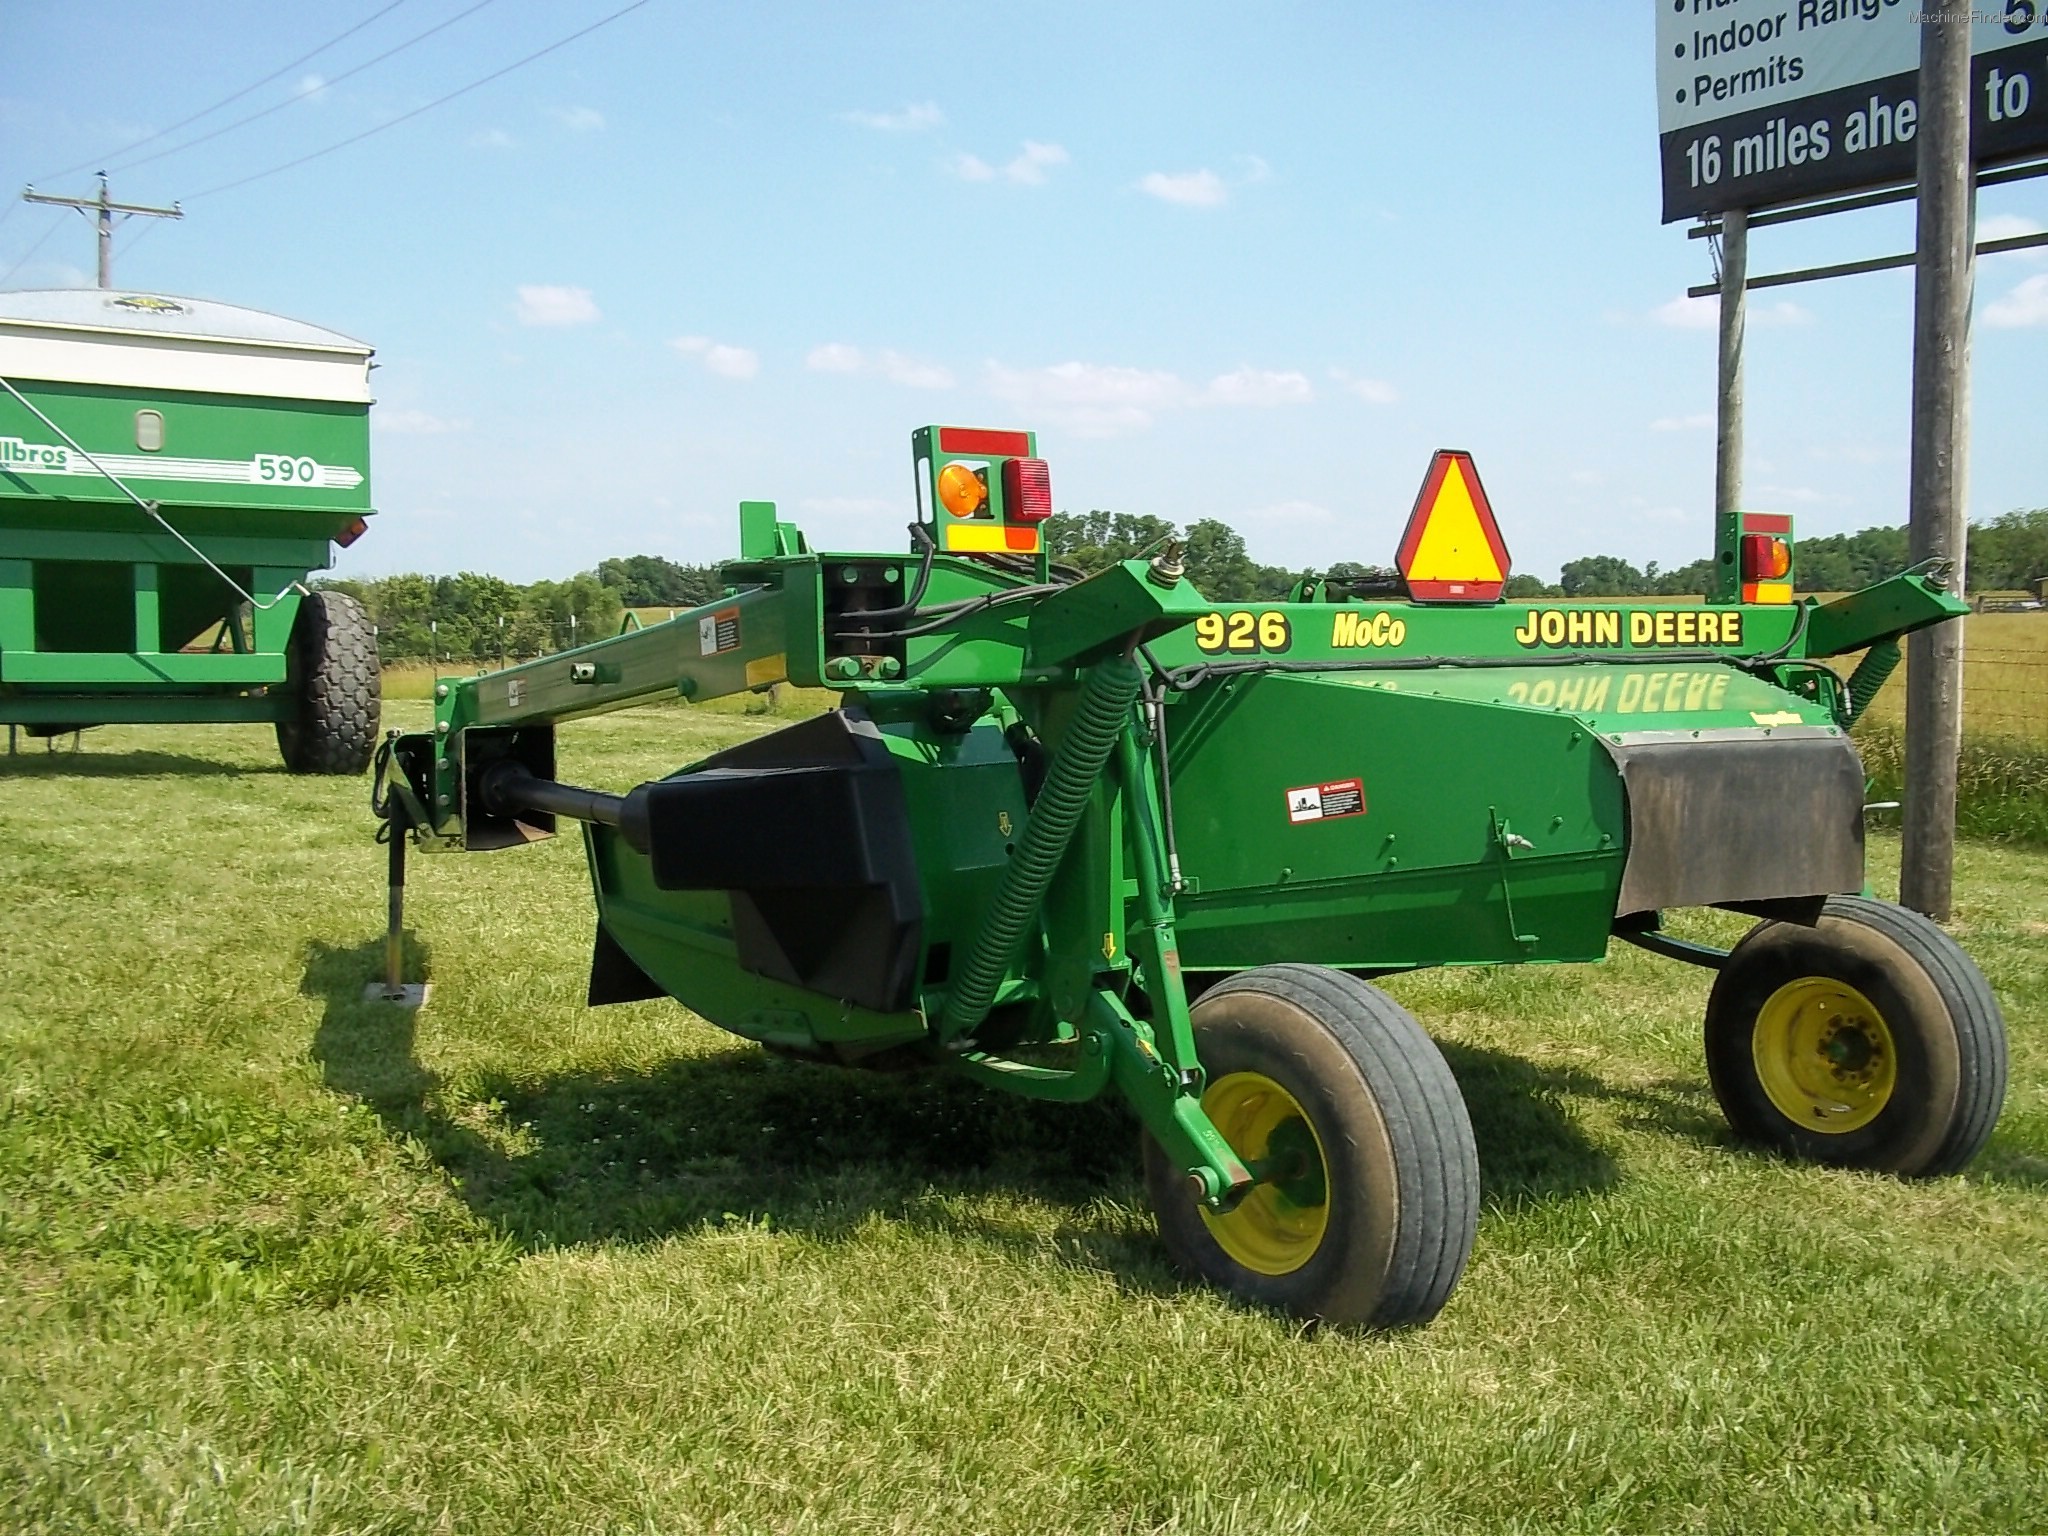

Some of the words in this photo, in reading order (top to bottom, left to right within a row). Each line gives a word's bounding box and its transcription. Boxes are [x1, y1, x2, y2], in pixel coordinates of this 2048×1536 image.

[1694, 12, 1787, 61] Indoor
[2004, 0, 2048, 35] 5
[1694, 55, 1804, 107] Permits
[1686, 135, 1722, 188] 16
[1733, 117, 1830, 178] miles
[1844, 95, 1918, 153] ahe
[1985, 68, 2030, 122] to
[0, 441, 67, 464] lbros
[260, 458, 314, 482] 590
[1196, 611, 1292, 656] 926
[1331, 611, 1406, 648] MoCo
[1516, 610, 1623, 648] JOHN
[1630, 611, 1743, 647] DEERE
